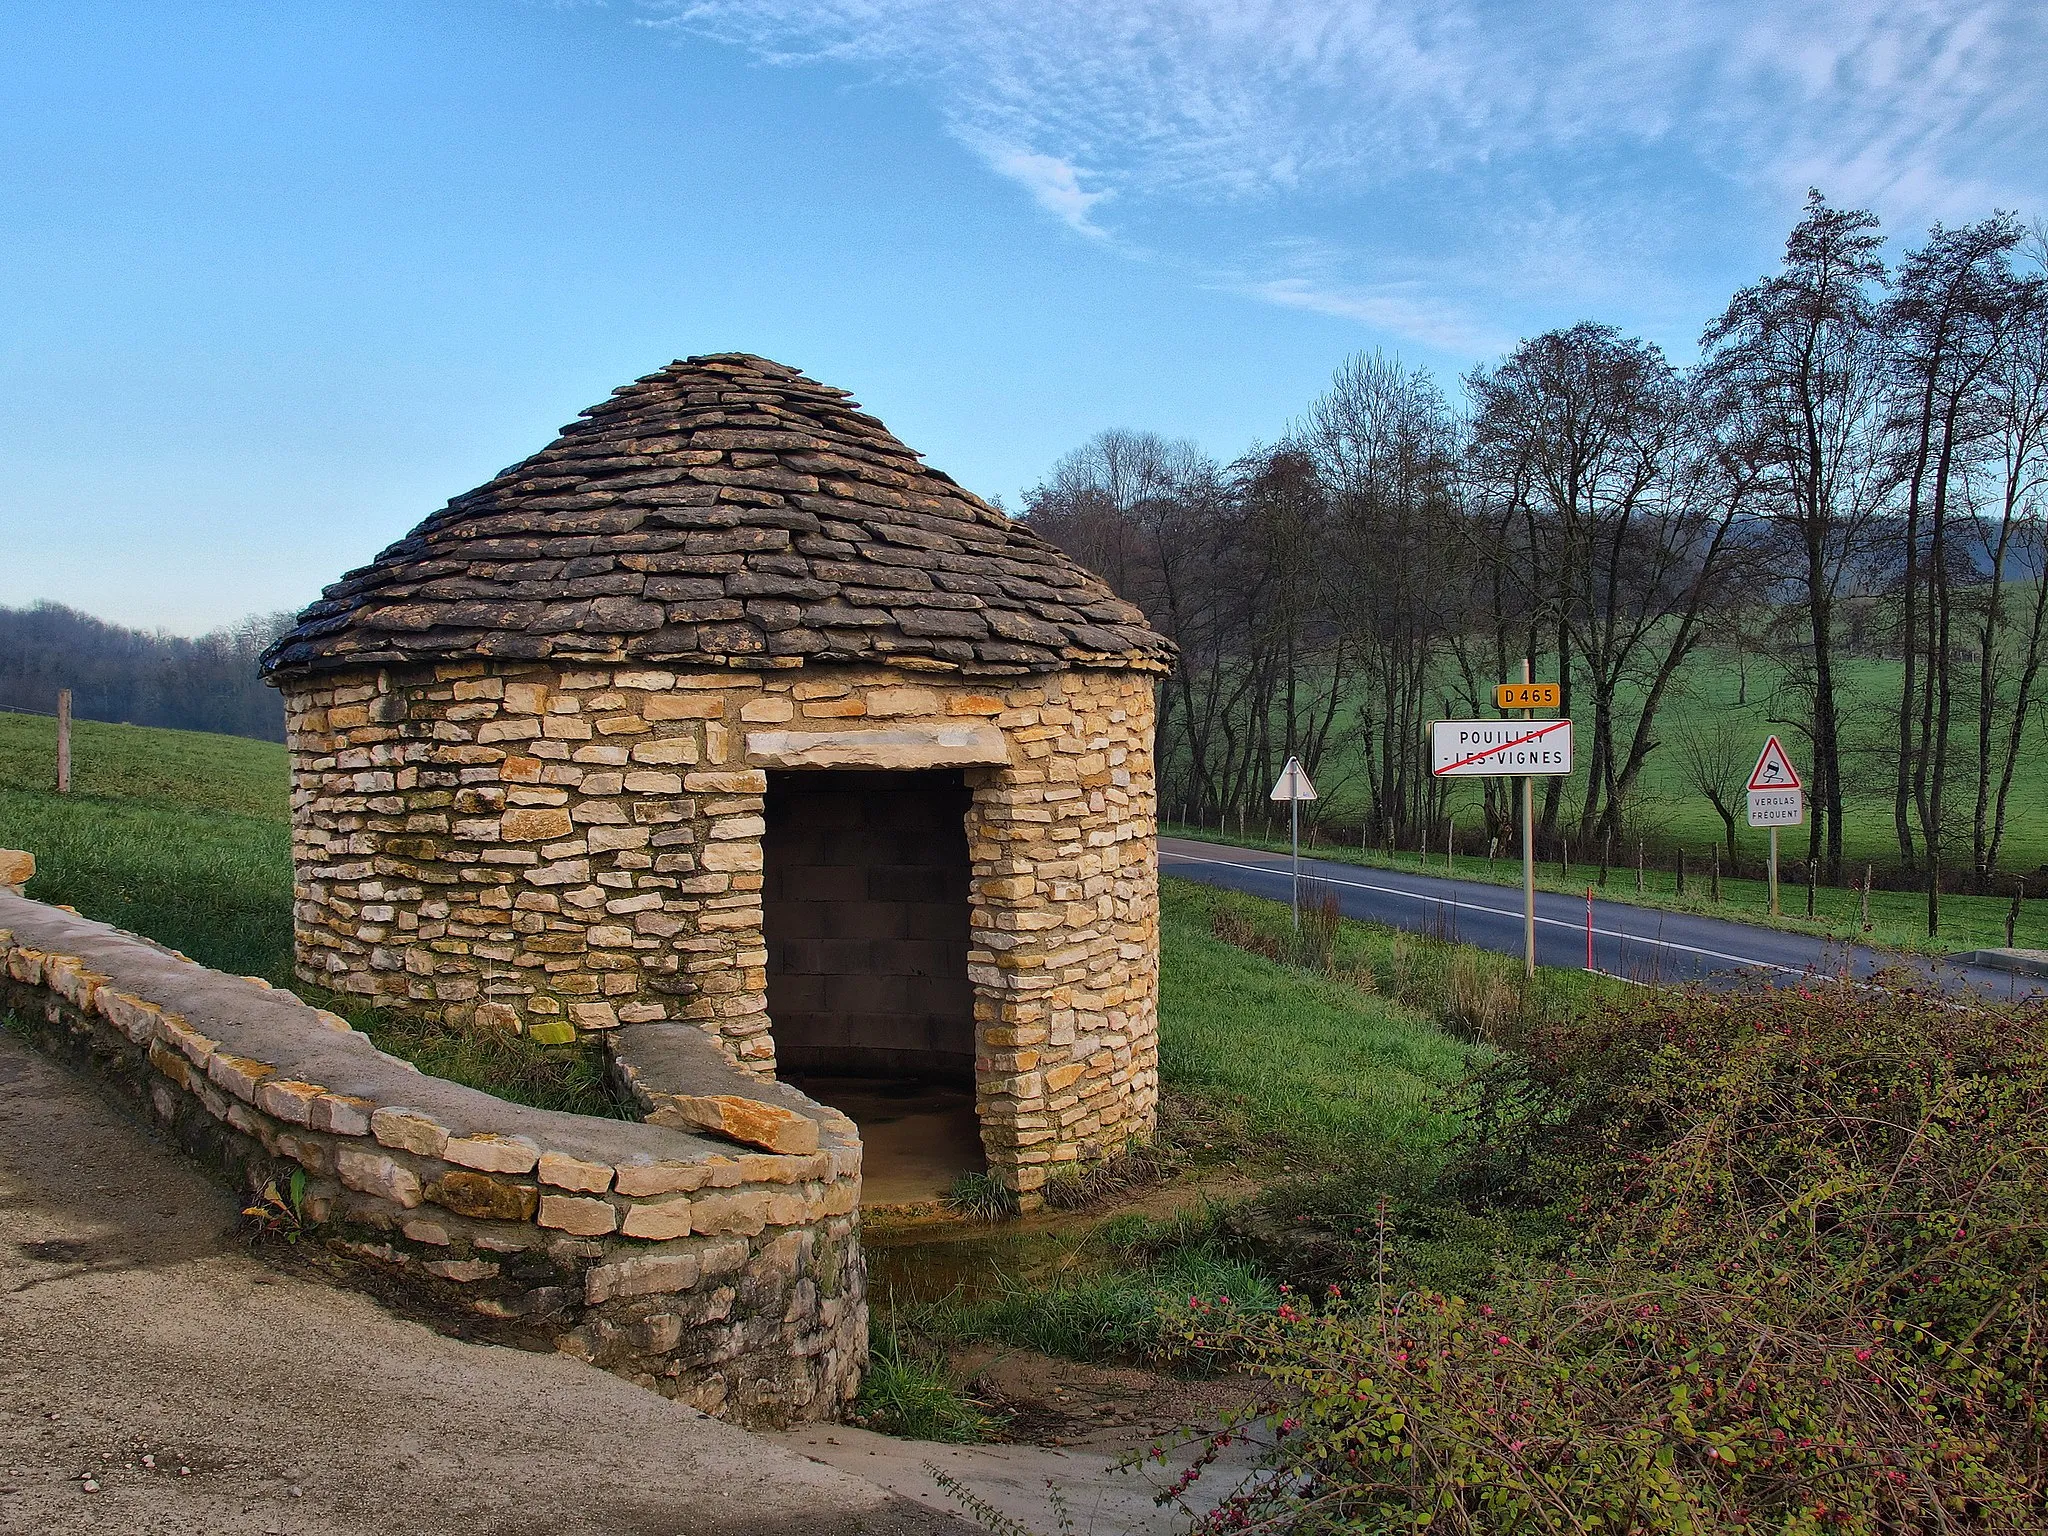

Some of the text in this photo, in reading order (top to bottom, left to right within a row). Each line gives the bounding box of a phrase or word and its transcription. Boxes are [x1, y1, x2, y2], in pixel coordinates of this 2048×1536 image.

[1505, 690, 1552, 703] D 465
[1460, 731, 1544, 744] POUILLEY
[1755, 797, 1795, 805] VERGLAS
